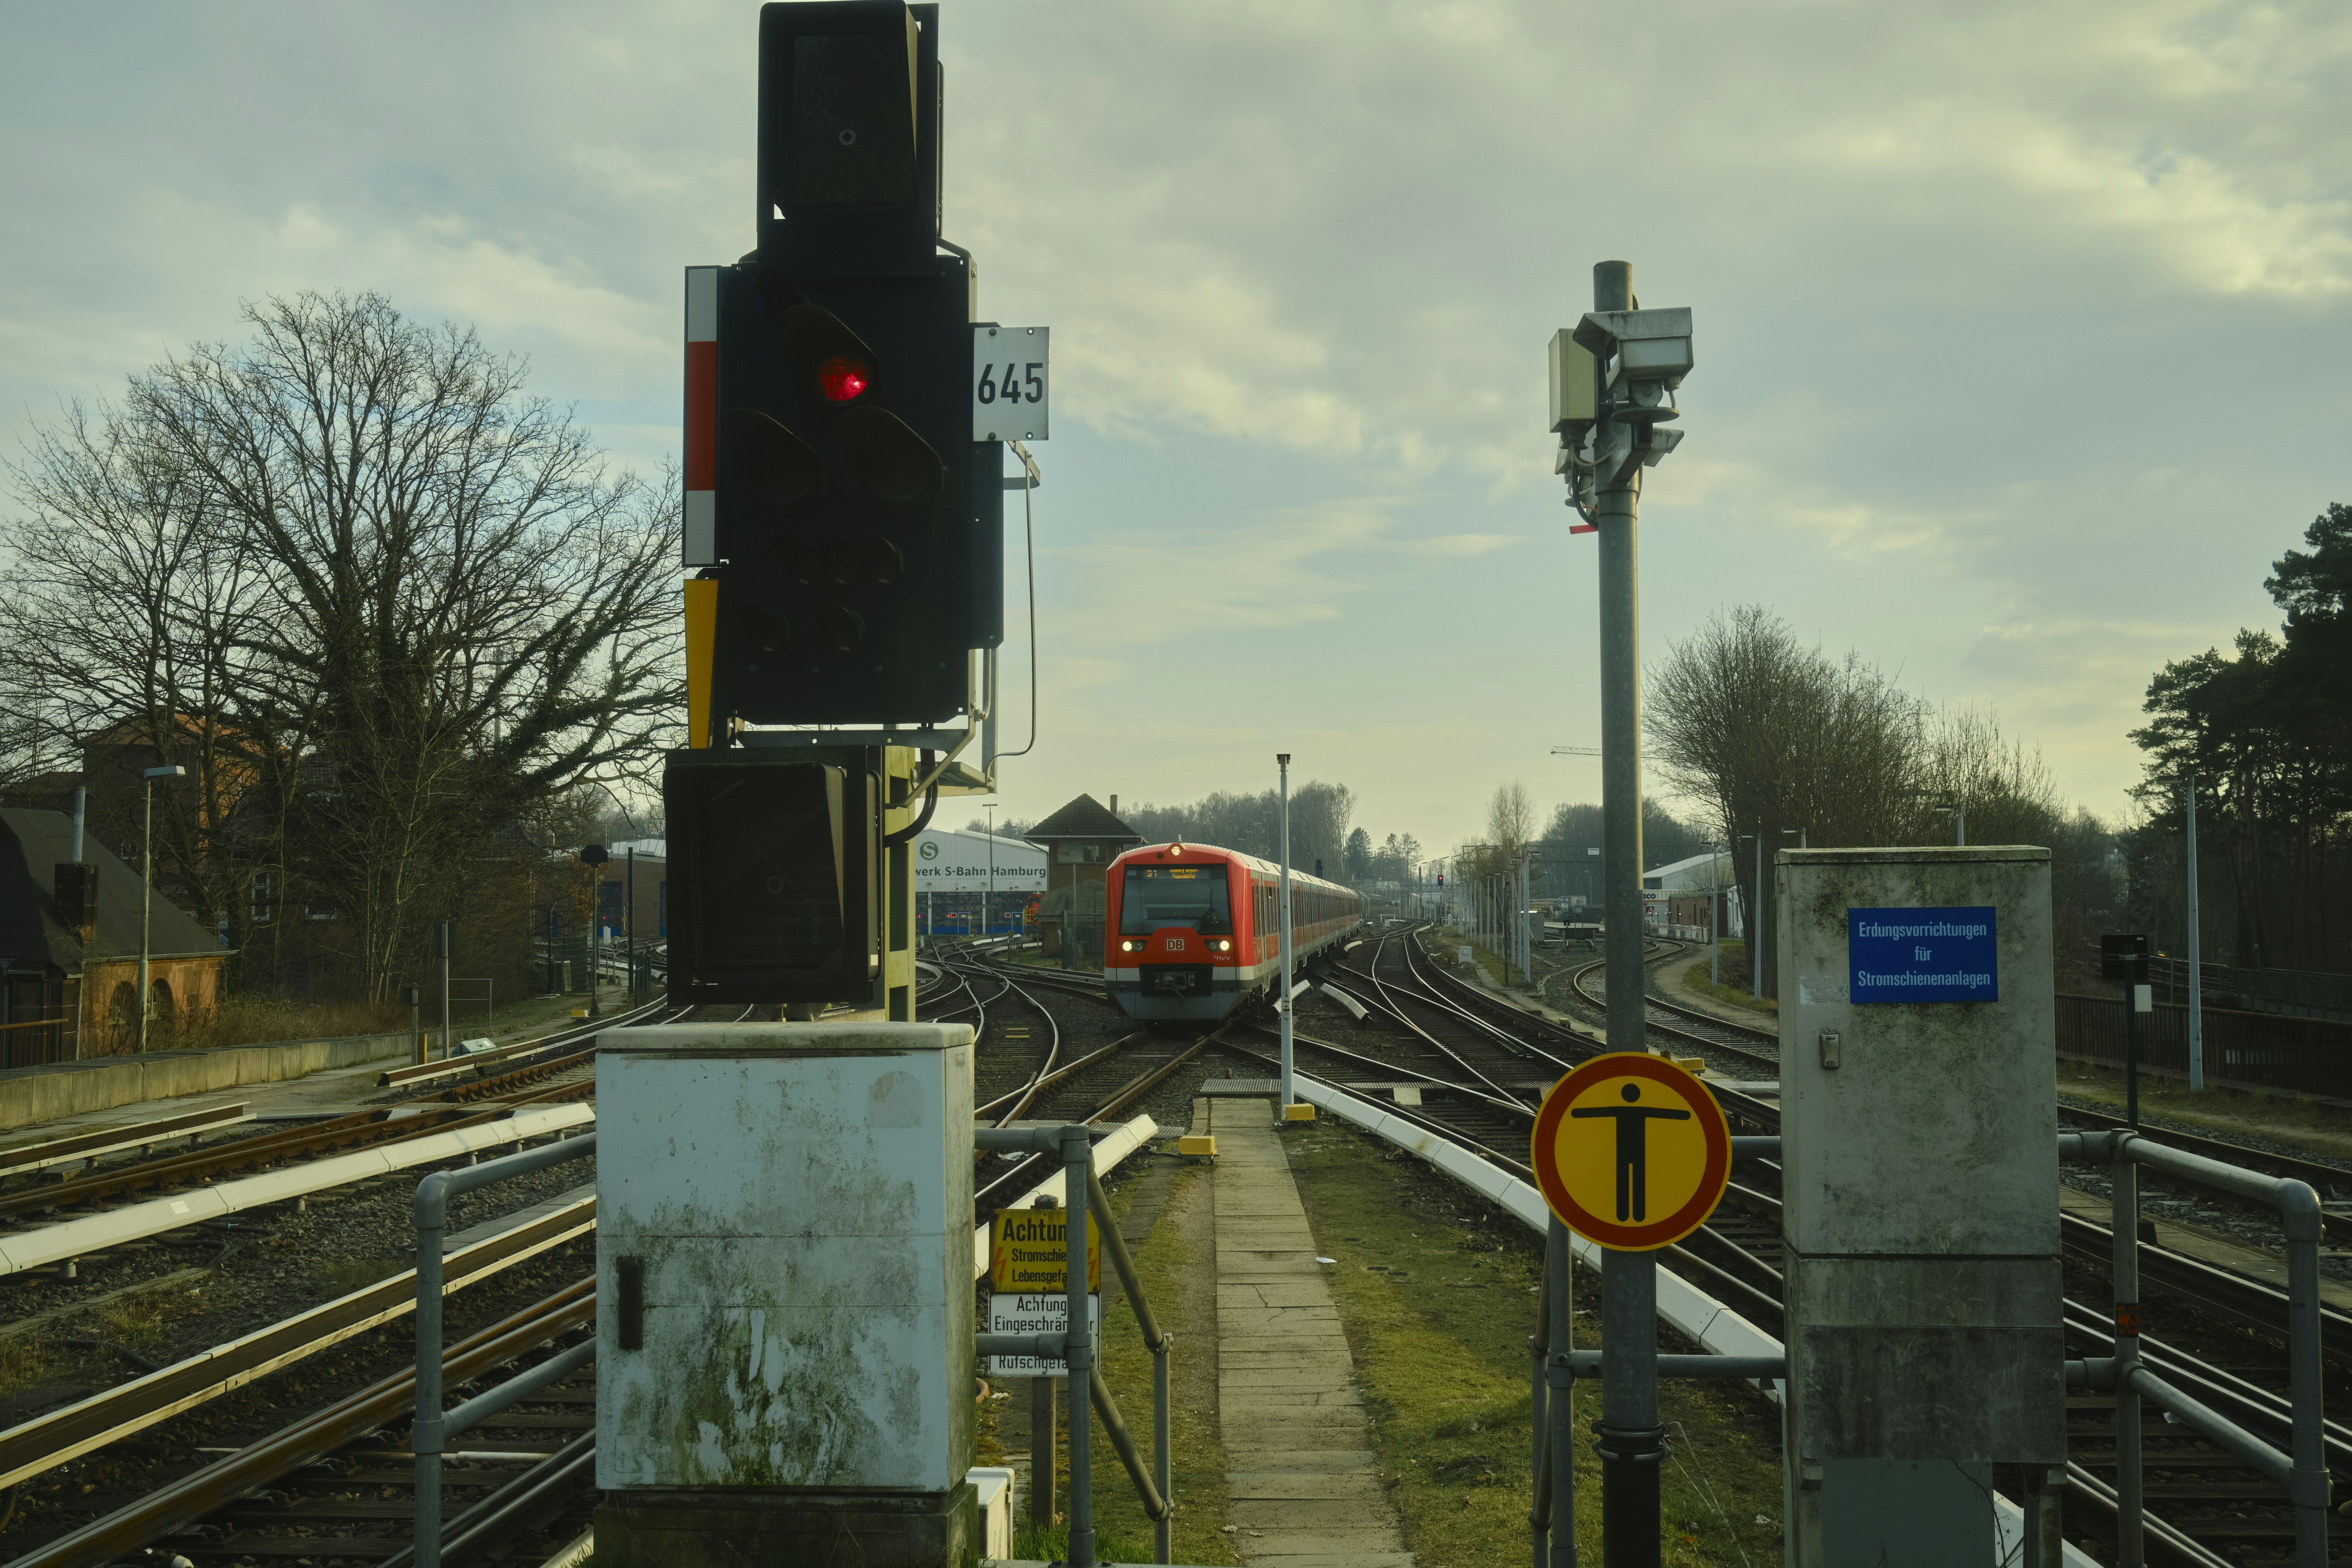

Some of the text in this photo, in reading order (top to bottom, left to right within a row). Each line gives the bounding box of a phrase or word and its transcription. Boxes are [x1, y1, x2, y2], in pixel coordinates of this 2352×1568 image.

[978, 363, 1043, 404] 645
[923, 843, 936, 859] S
[945, 867, 986, 876] S-Bahn
[992, 867, 1046, 878] Hamburg
[1859, 921, 1987, 940] Erdungsvorrichtungen
[1168, 940, 1184, 949] DB
[1914, 946, 1932, 961] für
[1858, 970, 1991, 989] Stromschienenanlagen
[1017, 1296, 1067, 1316] Achtung
